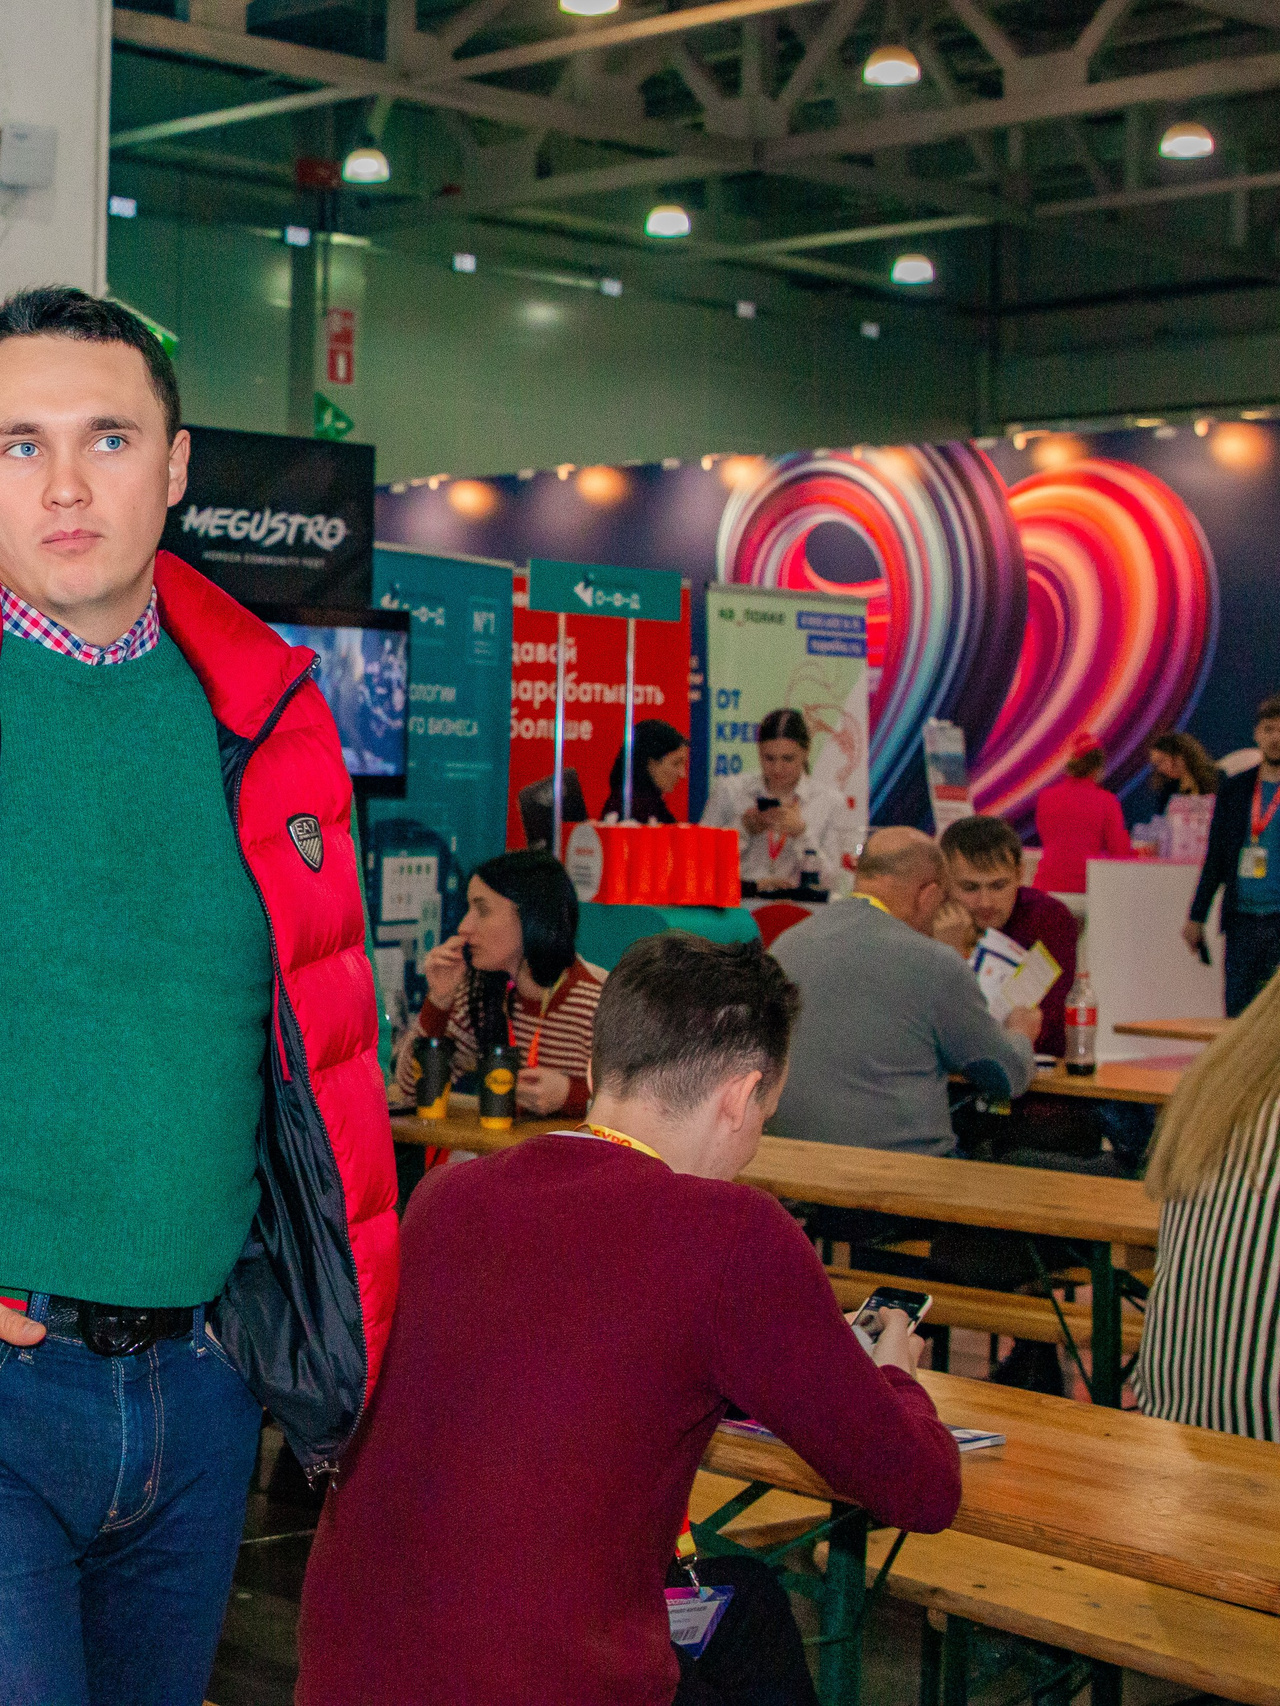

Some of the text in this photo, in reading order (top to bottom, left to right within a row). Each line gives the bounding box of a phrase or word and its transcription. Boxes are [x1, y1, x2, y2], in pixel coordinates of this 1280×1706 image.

[181, 504, 351, 551] MEGUSTRO
[716, 688, 742, 710] ОТ
[715, 753, 743, 776] ДО
[295, 820, 316, 835] EA7
